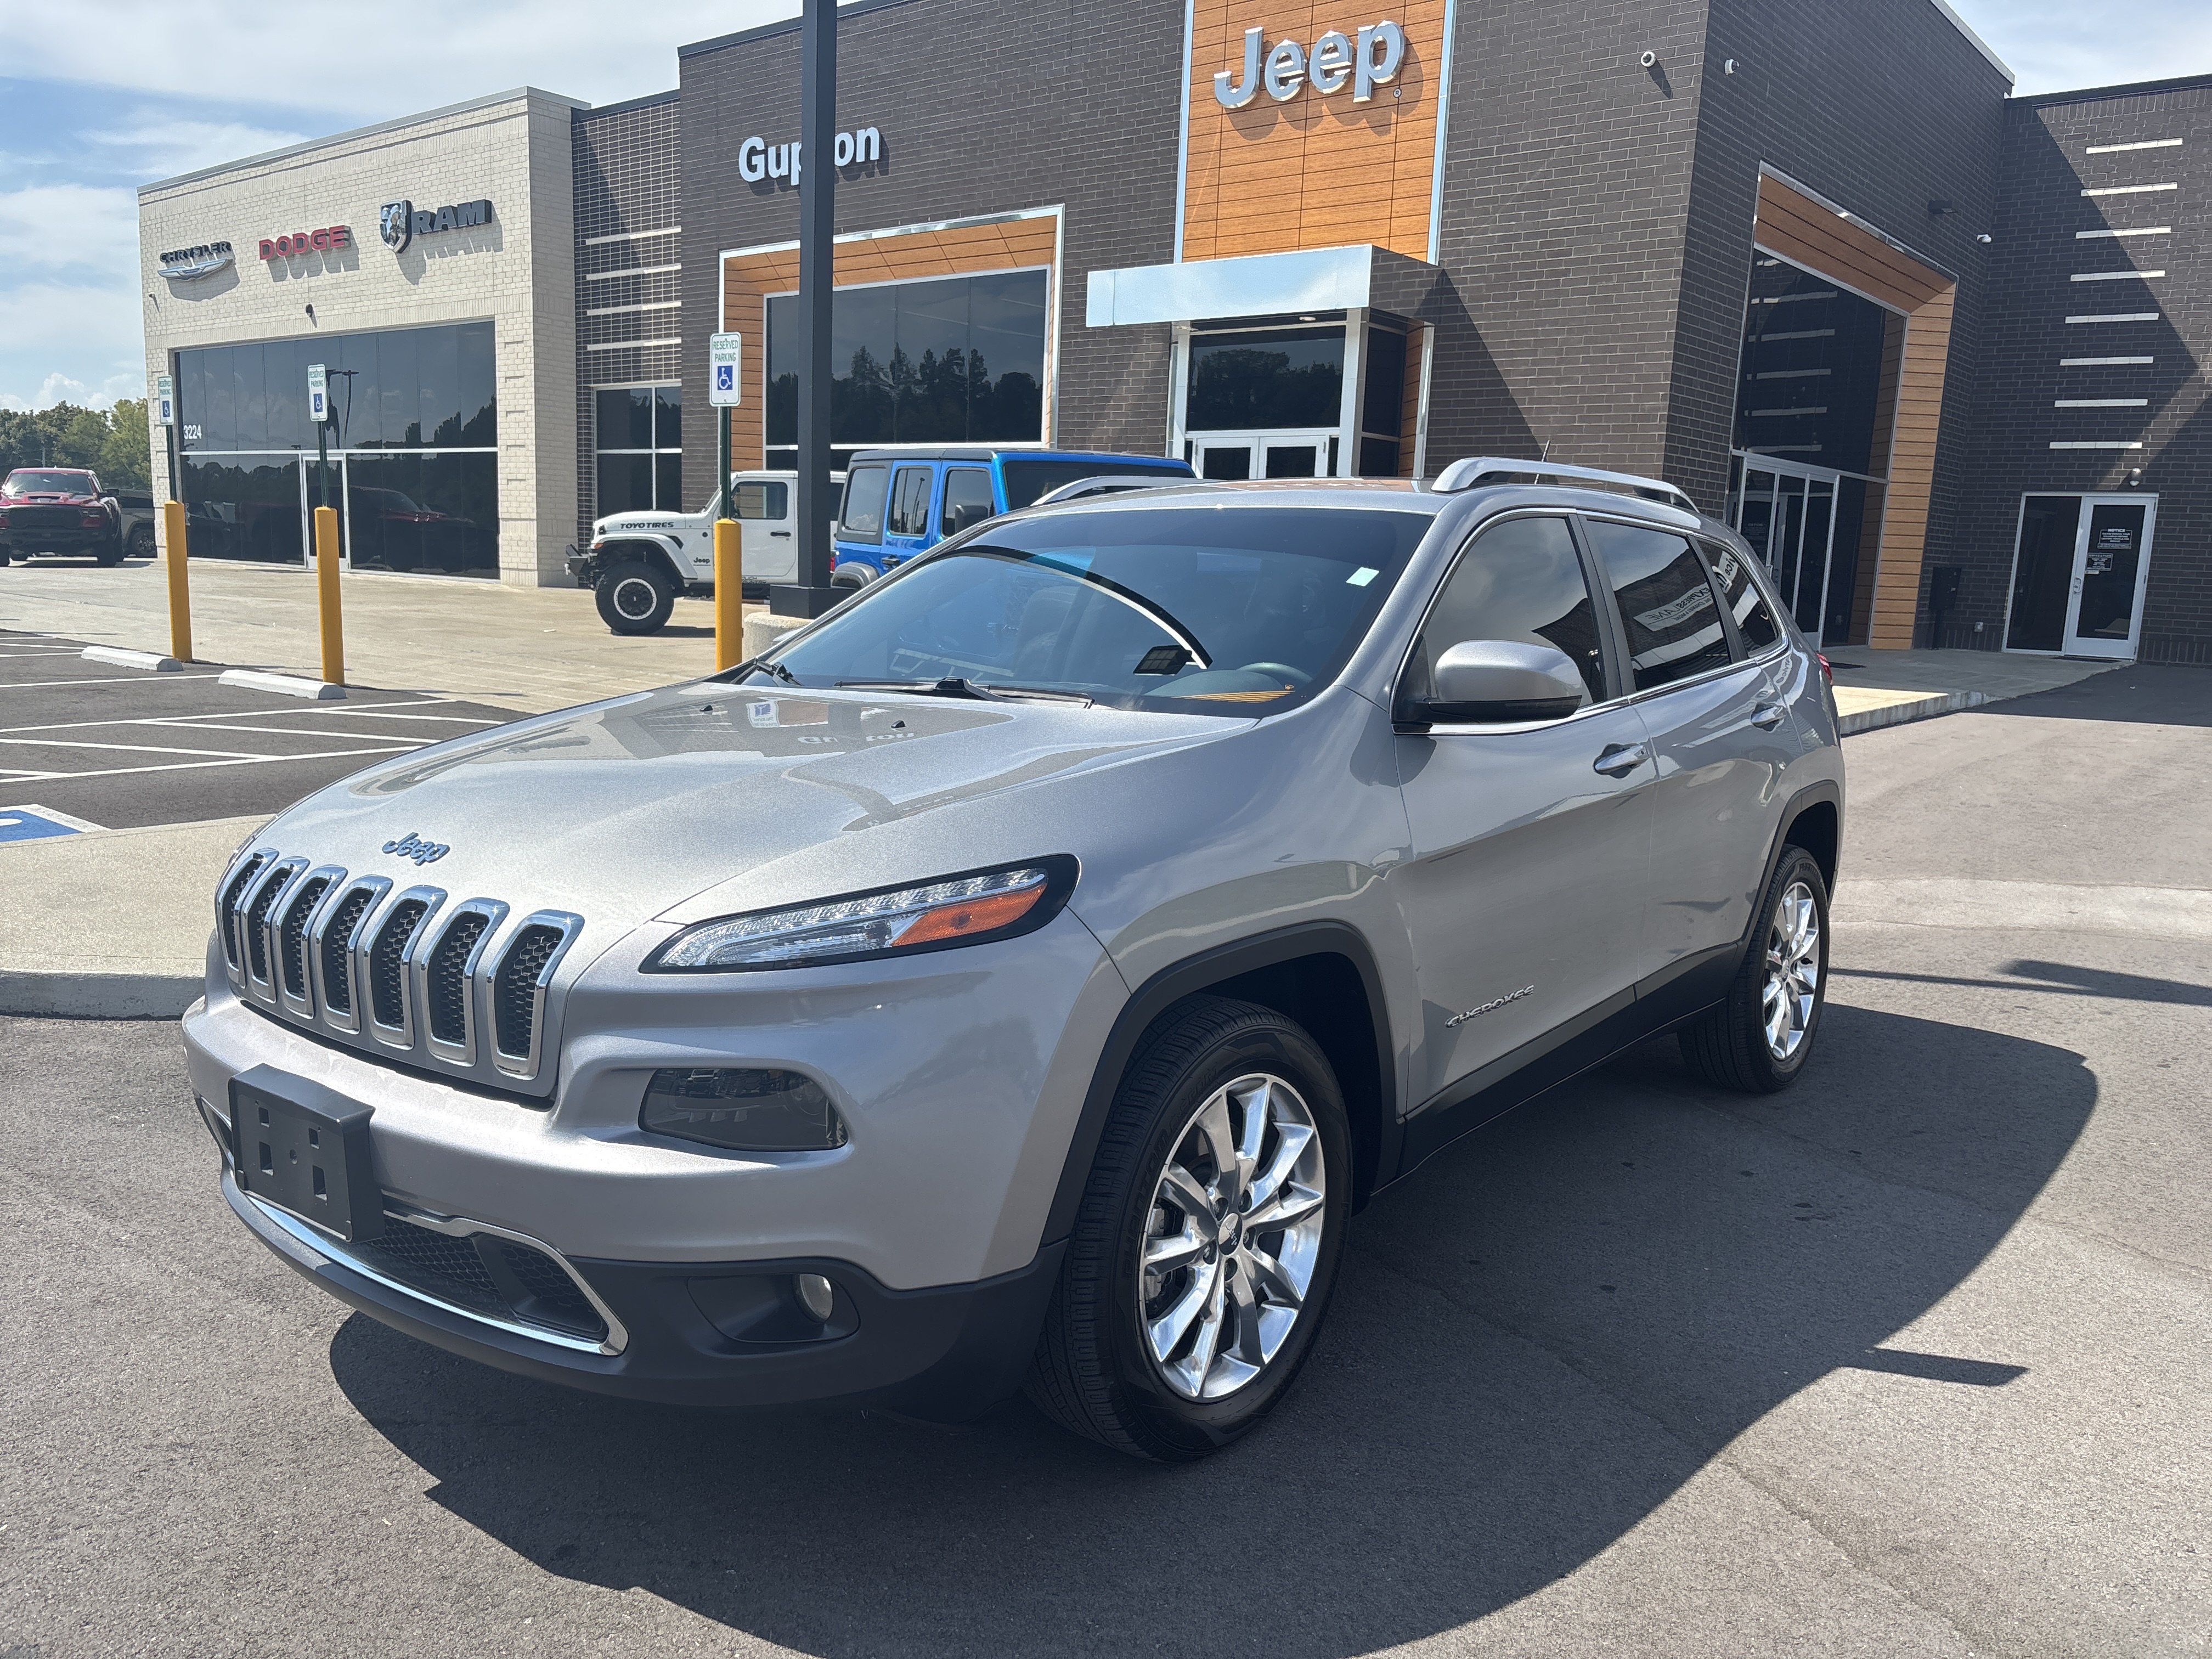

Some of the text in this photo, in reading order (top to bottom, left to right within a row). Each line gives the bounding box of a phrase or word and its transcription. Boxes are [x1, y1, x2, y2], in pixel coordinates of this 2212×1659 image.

[1214, 20, 1406, 108] Jeep
[738, 127, 879, 186] Gupon
[411, 200, 492, 235] RAM
[160, 241, 231, 263] CHRYSLER
[259, 225, 349, 260] DODGE
[713, 340, 738, 349] RESERVED
[715, 352, 736, 362] PARKING
[183, 424, 202, 439] 3224
[382, 832, 450, 866] Jeep
[1445, 985, 1534, 1028] CHEROKEE
